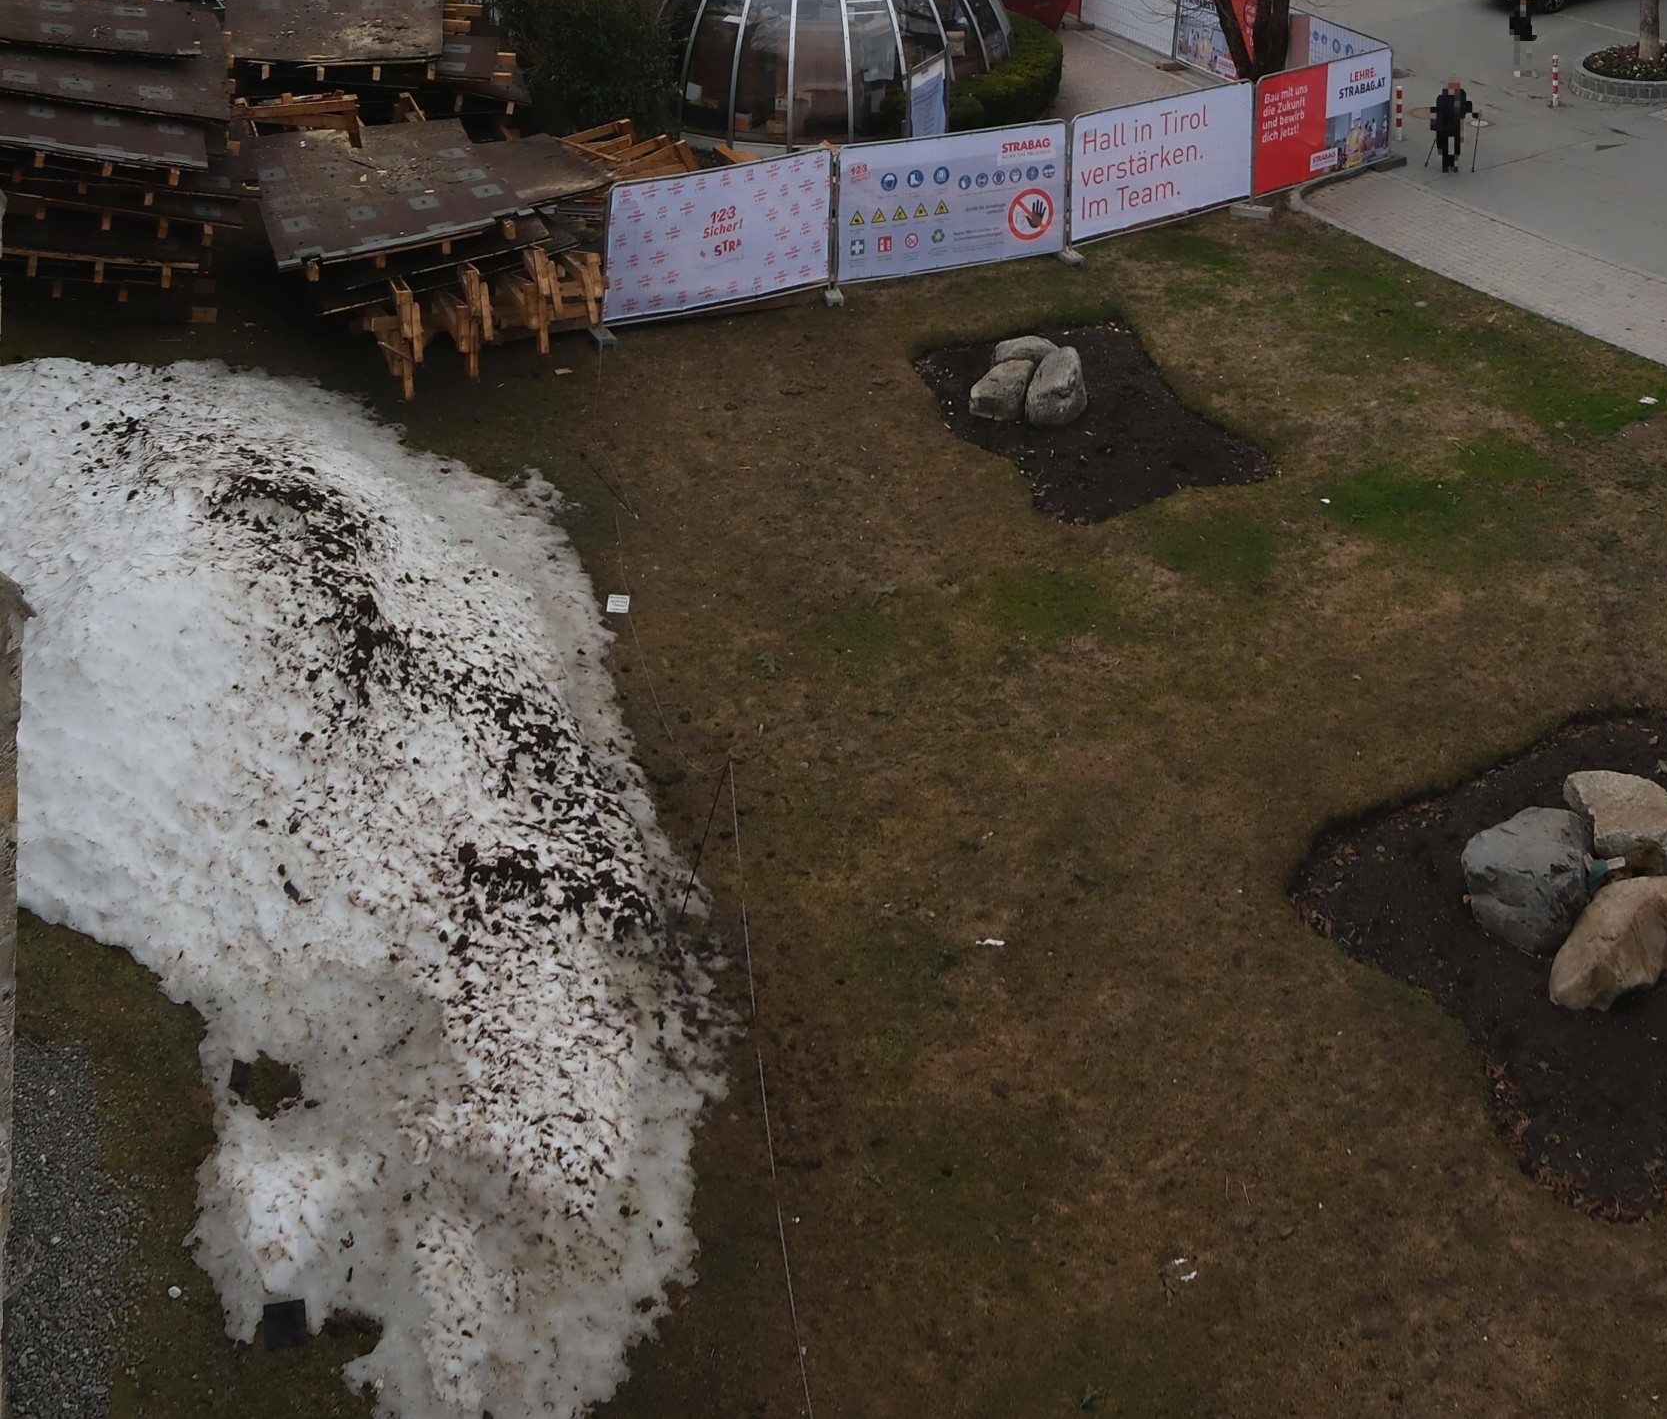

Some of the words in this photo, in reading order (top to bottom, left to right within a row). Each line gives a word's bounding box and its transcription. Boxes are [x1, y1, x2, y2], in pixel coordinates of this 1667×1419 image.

[1350, 67, 1377, 83] LEHRE.
[1264, 93, 1280, 104] Bau
[1281, 87, 1294, 98] mit
[1295, 85, 1308, 96] uns
[1339, 77, 1386, 99] STRABAG.AT
[1263, 106, 1276, 117] die
[1277, 97, 1306, 113] Zukunft
[1083, 122, 1127, 155] Hall
[1134, 119, 1152, 143] in
[1160, 104, 1208, 136] Tirol
[1262, 118, 1278, 130] und
[1279, 110, 1305, 125] bewirb
[1262, 130, 1278, 143] dich
[1279, 124, 1299, 140] jetzt!
[1001, 137, 1051, 153] STRABAG
[1081, 143, 1204, 187] verstärken.
[1081, 196, 1108, 220] Im
[1117, 181, 1181, 211] Team.
[703, 219, 744, 239] Sicher!
